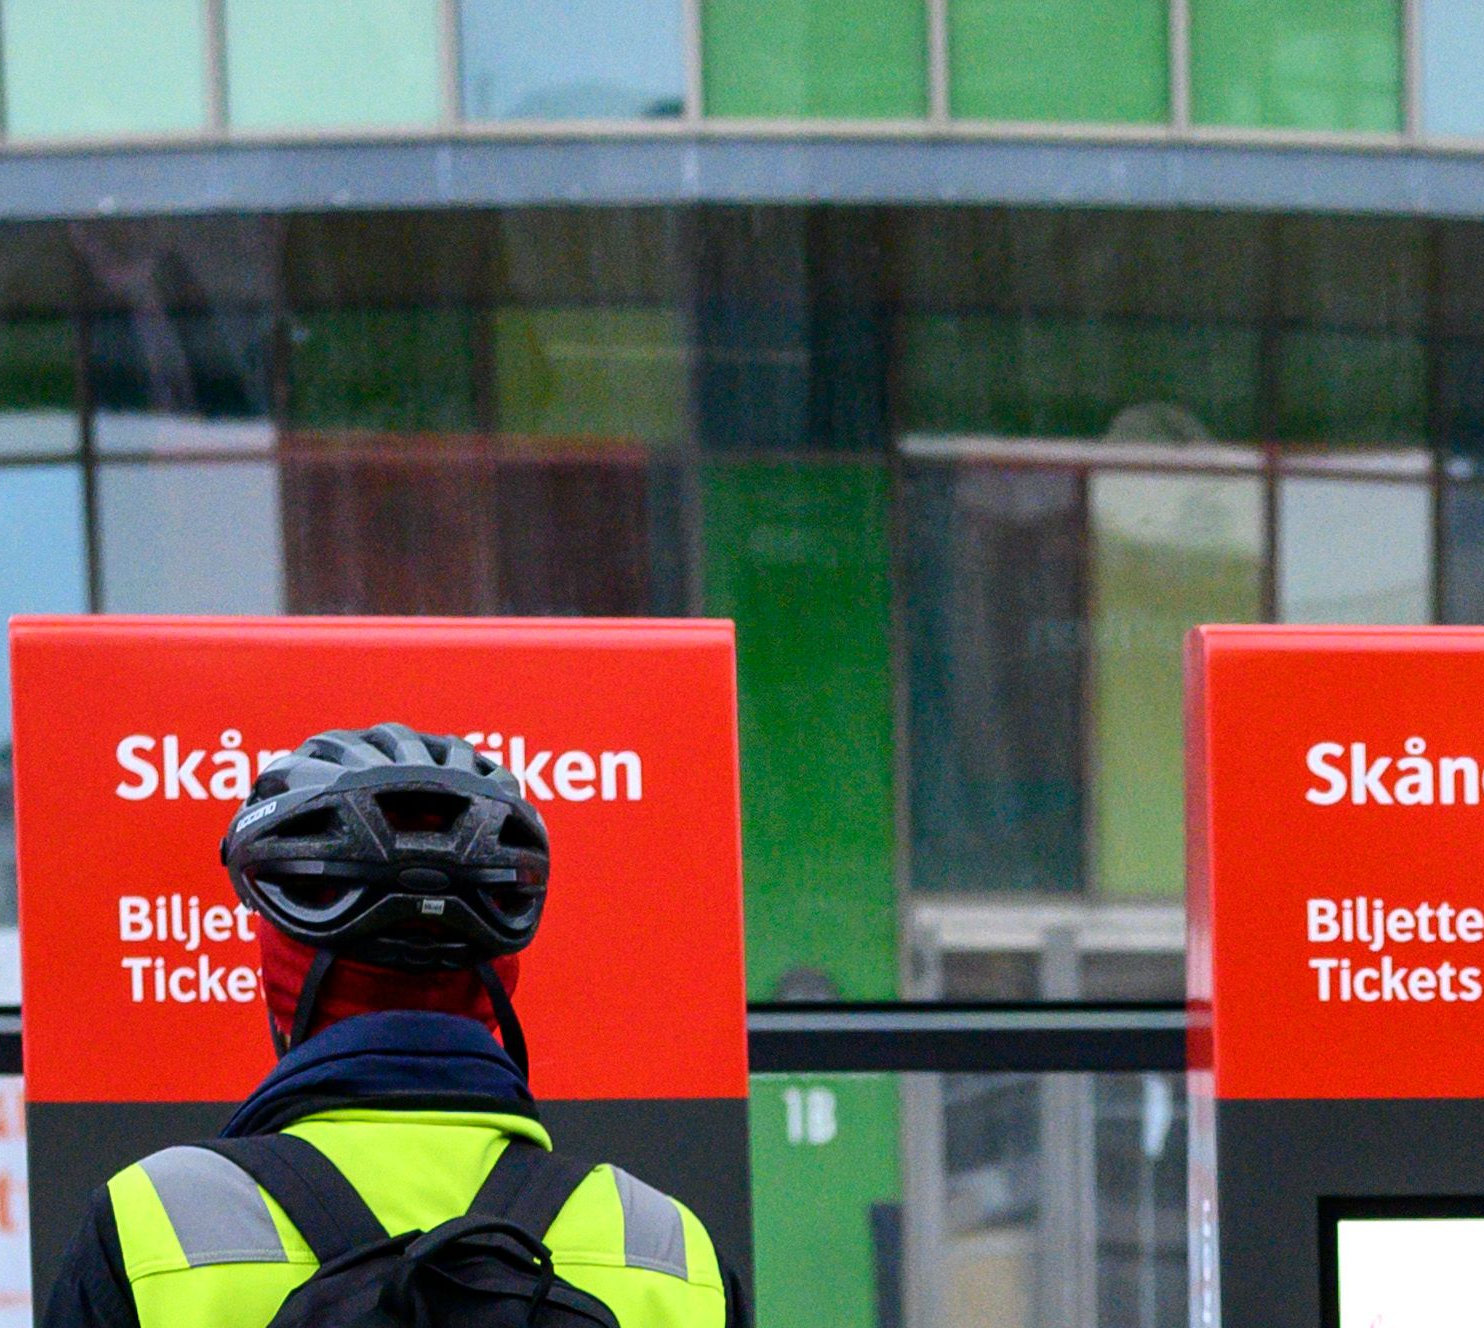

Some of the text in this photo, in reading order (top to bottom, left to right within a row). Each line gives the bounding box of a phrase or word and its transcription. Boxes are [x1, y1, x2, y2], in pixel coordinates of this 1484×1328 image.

[118, 892, 261, 951] Biljet
[121, 953, 266, 1003] Ticke
[1307, 955, 1483, 1003] Tickets
